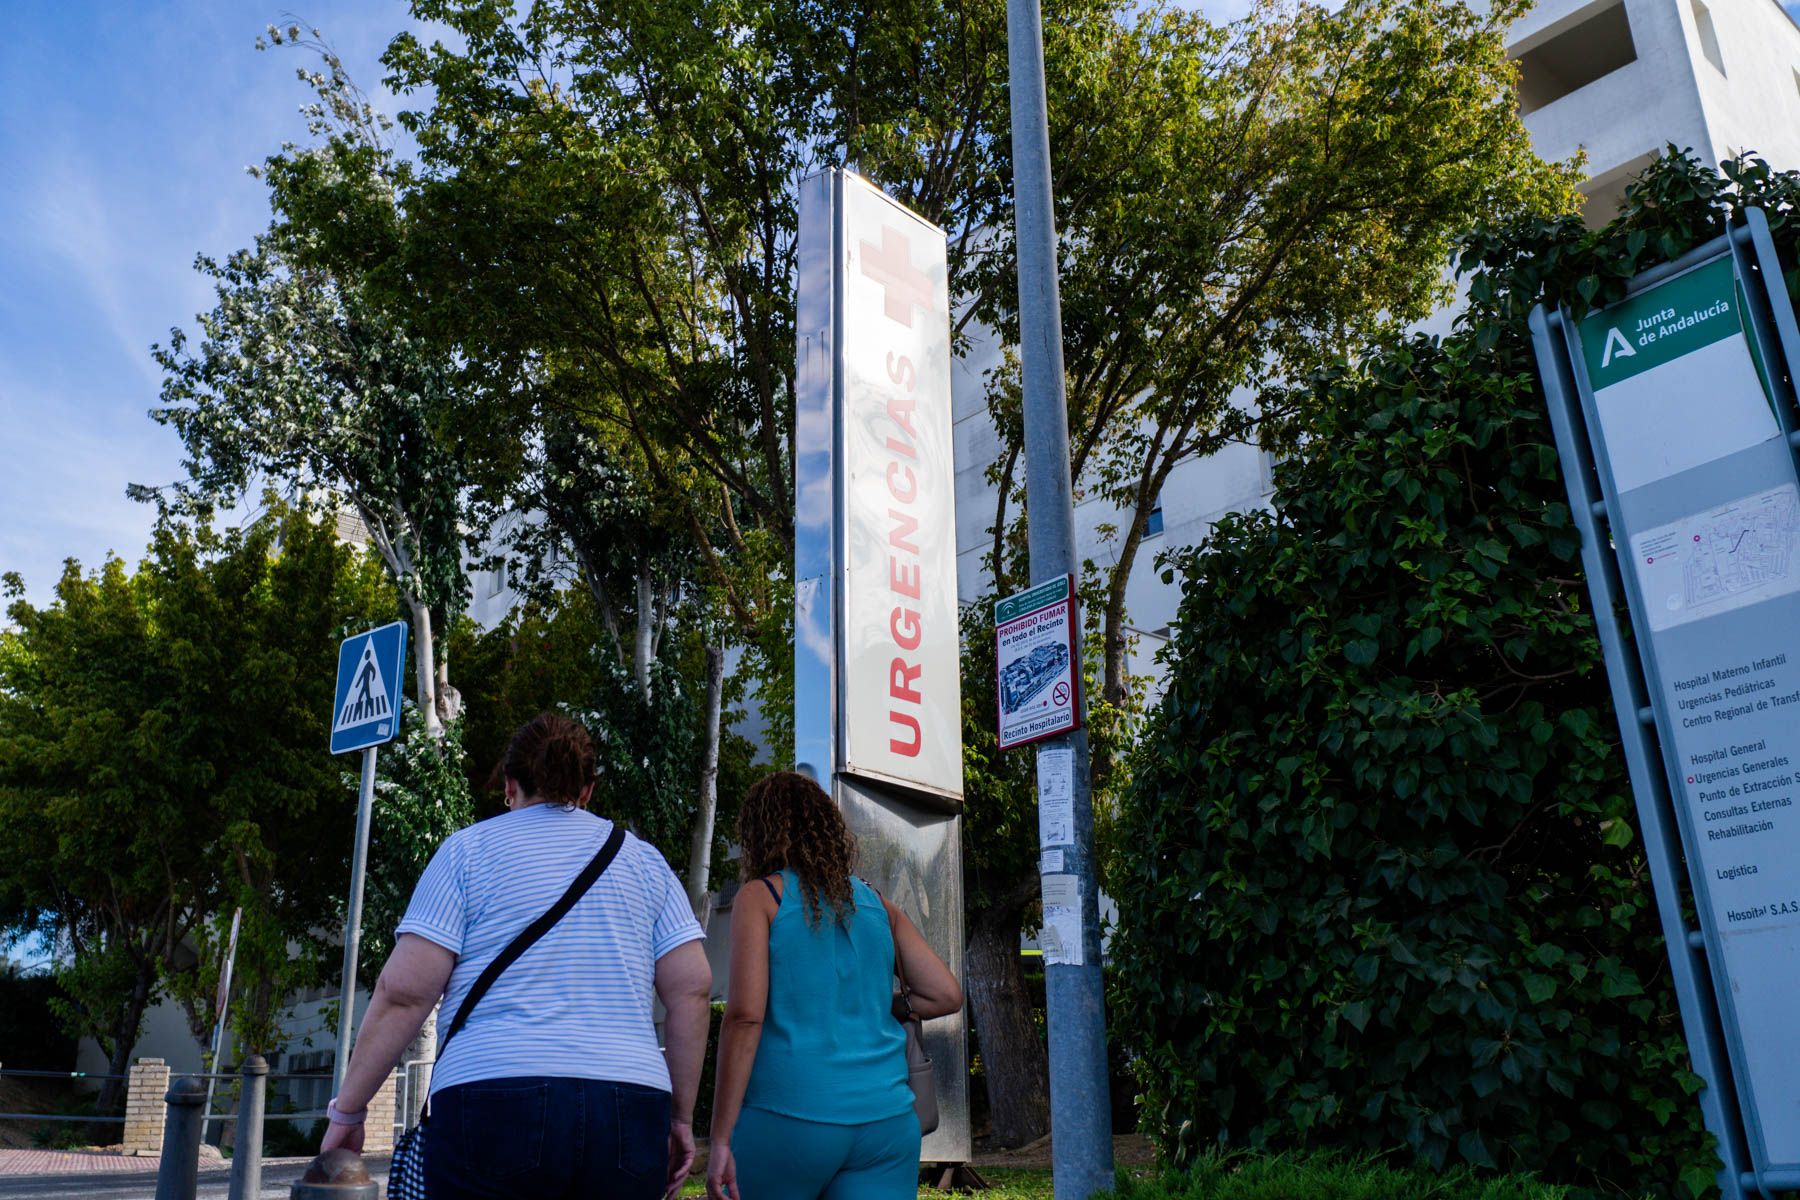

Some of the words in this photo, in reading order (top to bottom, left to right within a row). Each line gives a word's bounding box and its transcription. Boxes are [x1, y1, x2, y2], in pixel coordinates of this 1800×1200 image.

[1636, 308, 1676, 332] Junta
[1639, 333, 1656, 346] de
[1659, 300, 1729, 338] Andalucía
[886, 351, 922, 757] URGENCIAS
[999, 617, 1038, 638] PROHIBIDO
[1039, 606, 1066, 622] FUMAR
[1012, 632, 1028, 641] todo
[1028, 629, 1036, 638] el
[1037, 618, 1064, 633] Recinto
[1674, 674, 1710, 692] Hospital
[1712, 665, 1750, 682] Materno
[1752, 653, 1787, 671] Infantil
[1678, 692, 1722, 710] Urgencias
[1724, 679, 1776, 699] Pediátricas
[1003, 726, 1028, 740] Recinto
[1029, 712, 1070, 732] Hospitalario
[1682, 714, 1712, 729] Centro
[1714, 703, 1754, 721] Regional
[1756, 700, 1769, 711] de
[1690, 748, 1727, 766] Hospital
[1730, 739, 1766, 756] General
[1694, 766, 1740, 784] Urgencias
[1742, 756, 1789, 774] Generales
[1699, 789, 1726, 803] Punto
[1729, 786, 1741, 797] de
[1743, 774, 1792, 794] Extracción
[1704, 806, 1748, 822] Consultas
[1751, 797, 1792, 812] Externas
[1707, 820, 1774, 841] Rehabilitación
[1727, 906, 1767, 922] Hospital
